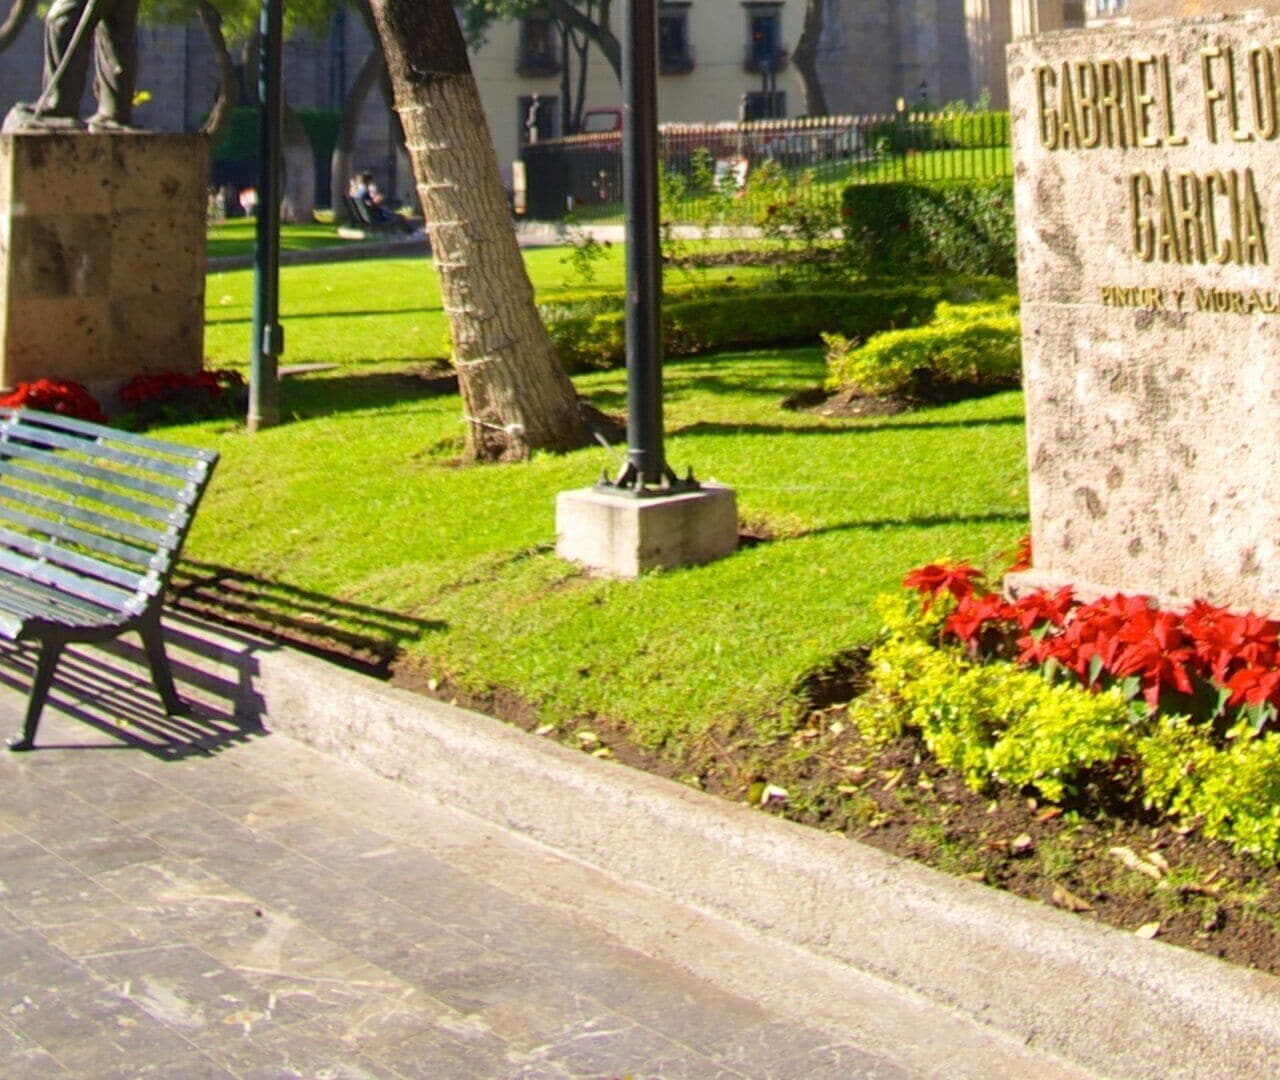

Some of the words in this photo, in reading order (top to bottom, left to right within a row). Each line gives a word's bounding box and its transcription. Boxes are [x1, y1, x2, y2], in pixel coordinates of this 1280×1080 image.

[1035, 52, 1189, 151] GABRIEL
[1129, 167, 1269, 266] GARCIA
[1101, 285, 1163, 309] PINTOR
[1172, 289, 1185, 309] Y
